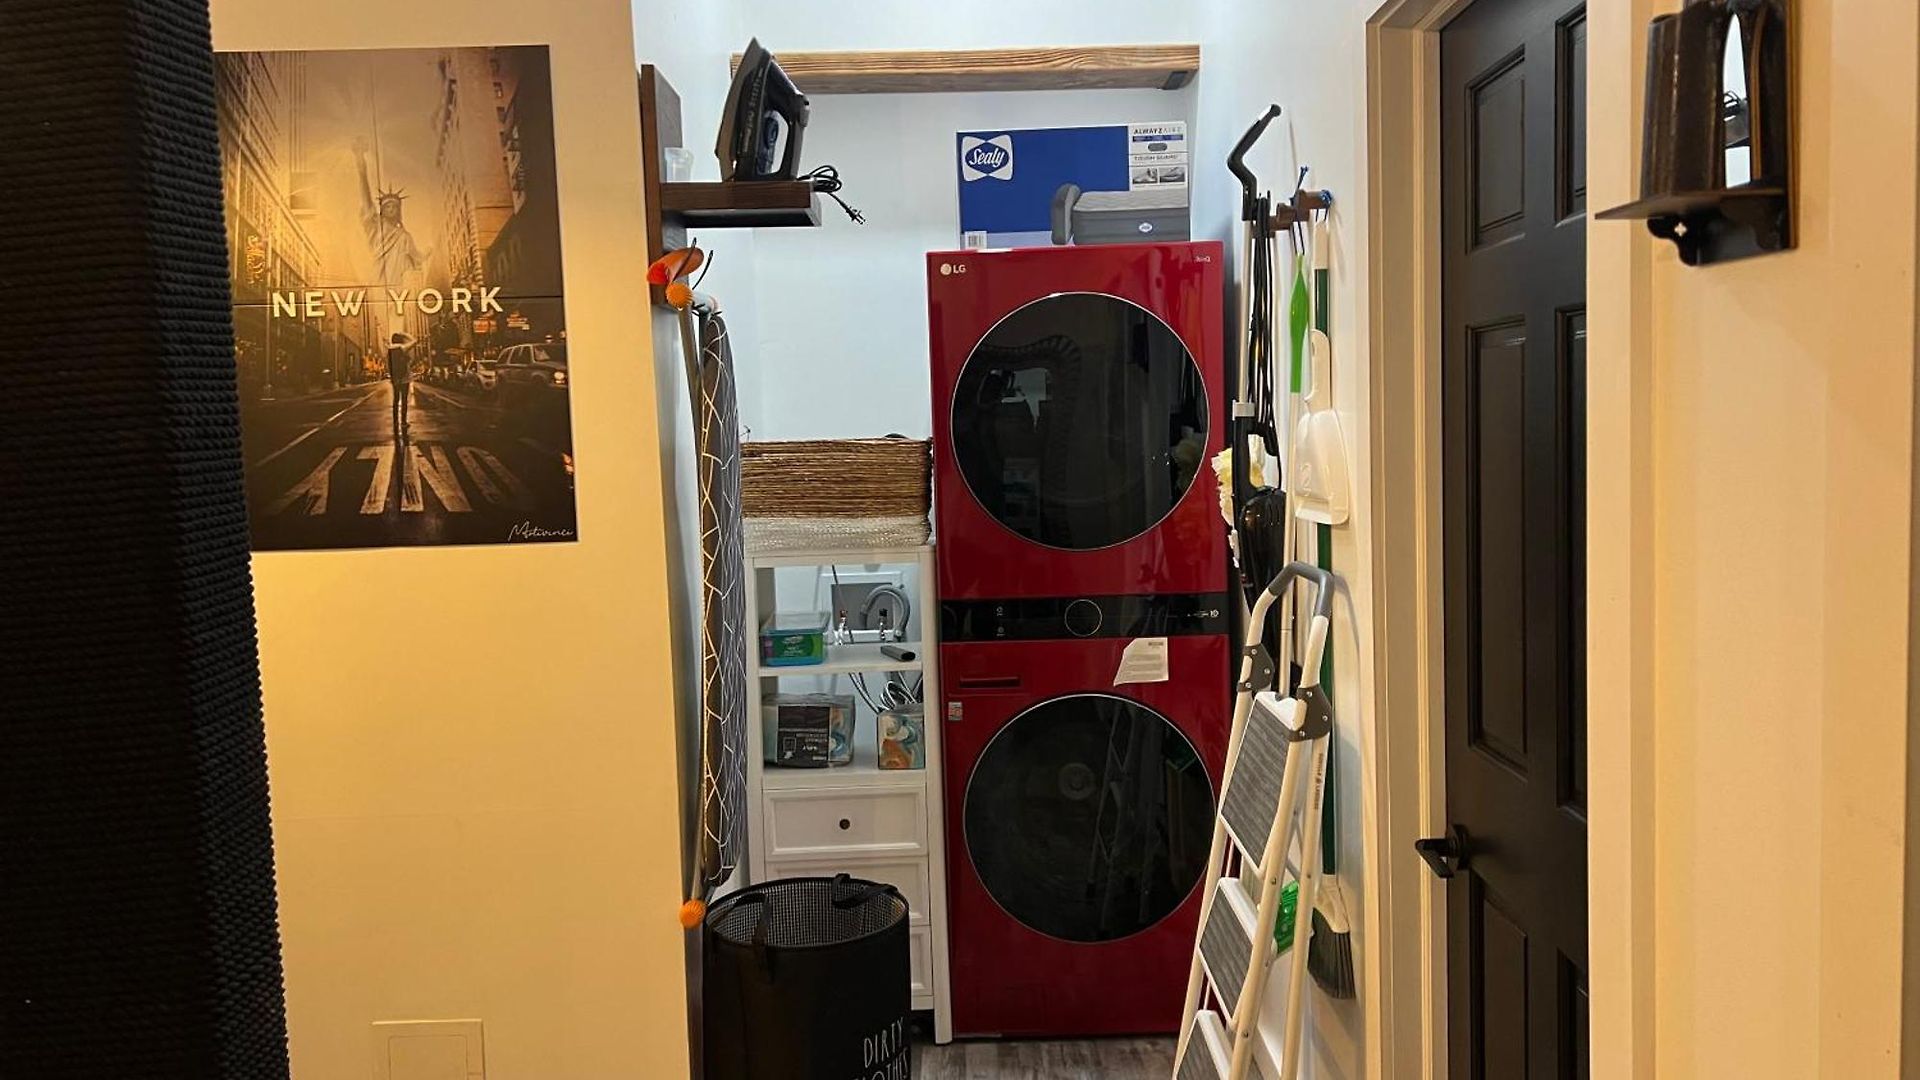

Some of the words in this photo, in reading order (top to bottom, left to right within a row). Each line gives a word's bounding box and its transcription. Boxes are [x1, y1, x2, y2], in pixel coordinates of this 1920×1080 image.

[969, 148, 1005, 167] Sealy
[953, 264, 966, 274] LG
[273, 290, 366, 317] NEW
[389, 286, 503, 315] YORK
[863, 1017, 904, 1068] DIRTY
[854, 1048, 908, 1080] THES
